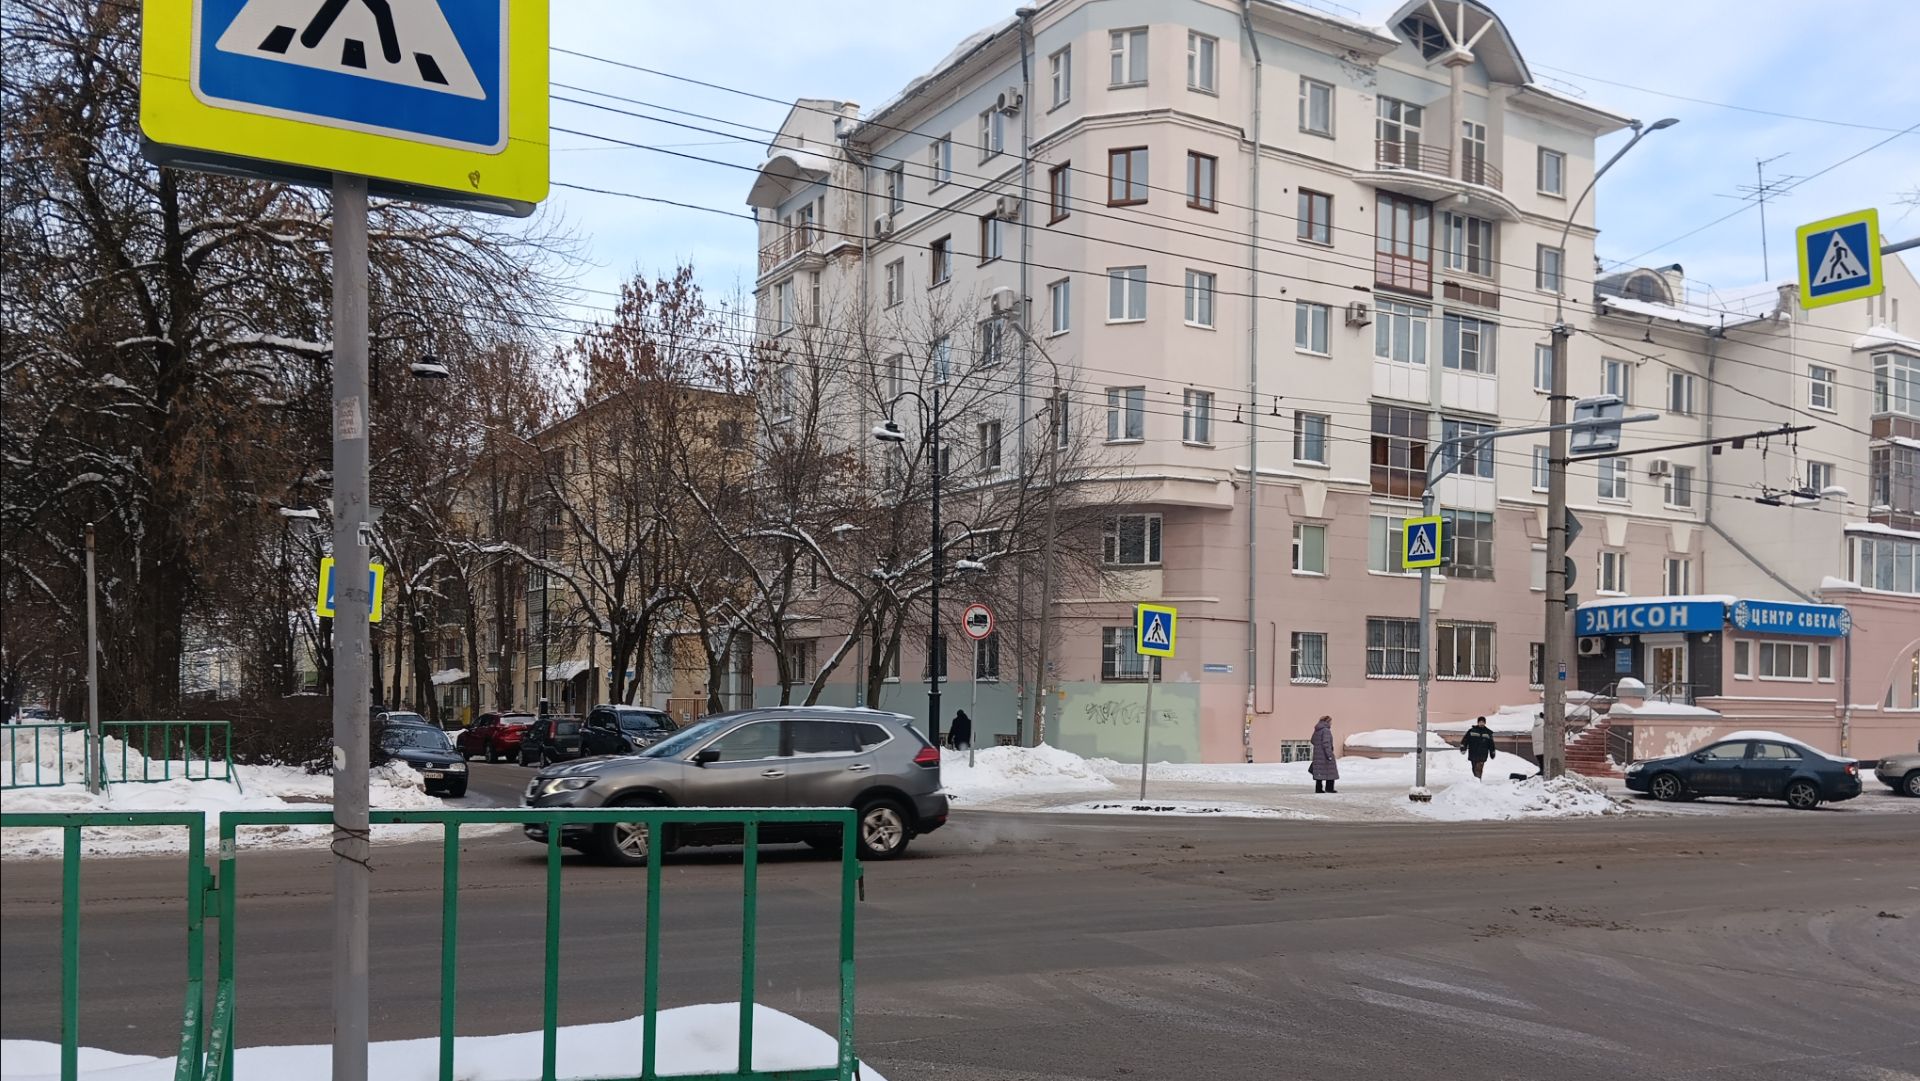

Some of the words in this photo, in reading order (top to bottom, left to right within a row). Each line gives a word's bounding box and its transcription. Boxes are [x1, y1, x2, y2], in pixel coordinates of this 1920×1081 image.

[1586, 605, 1688, 631] ЭДИСОН
[1751, 608, 1793, 627] ЦЕНТР
[1798, 613, 1837, 629] СВЕТА
